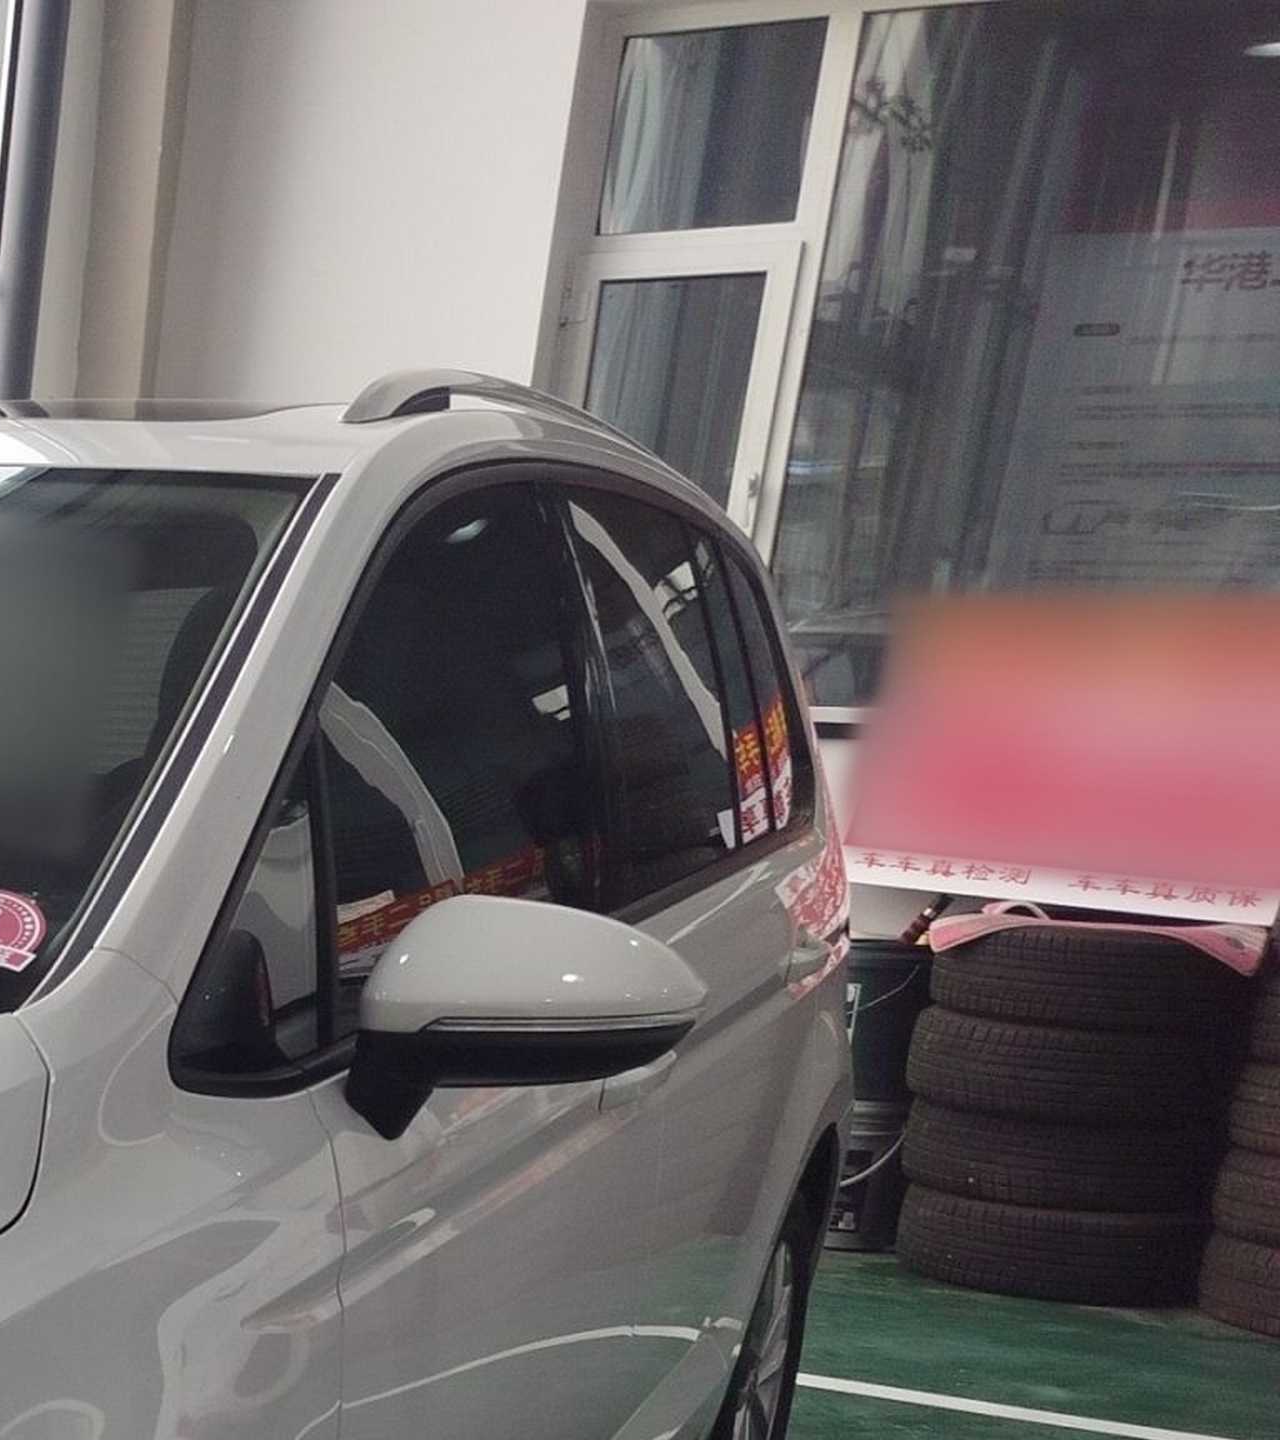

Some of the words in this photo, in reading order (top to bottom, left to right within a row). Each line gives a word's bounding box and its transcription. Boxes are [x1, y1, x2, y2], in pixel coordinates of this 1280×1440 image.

[1181, 250, 1280, 293] 华港
[854, 850, 1034, 887] 车车真检测
[1067, 873, 1263, 910] 车车真质保
